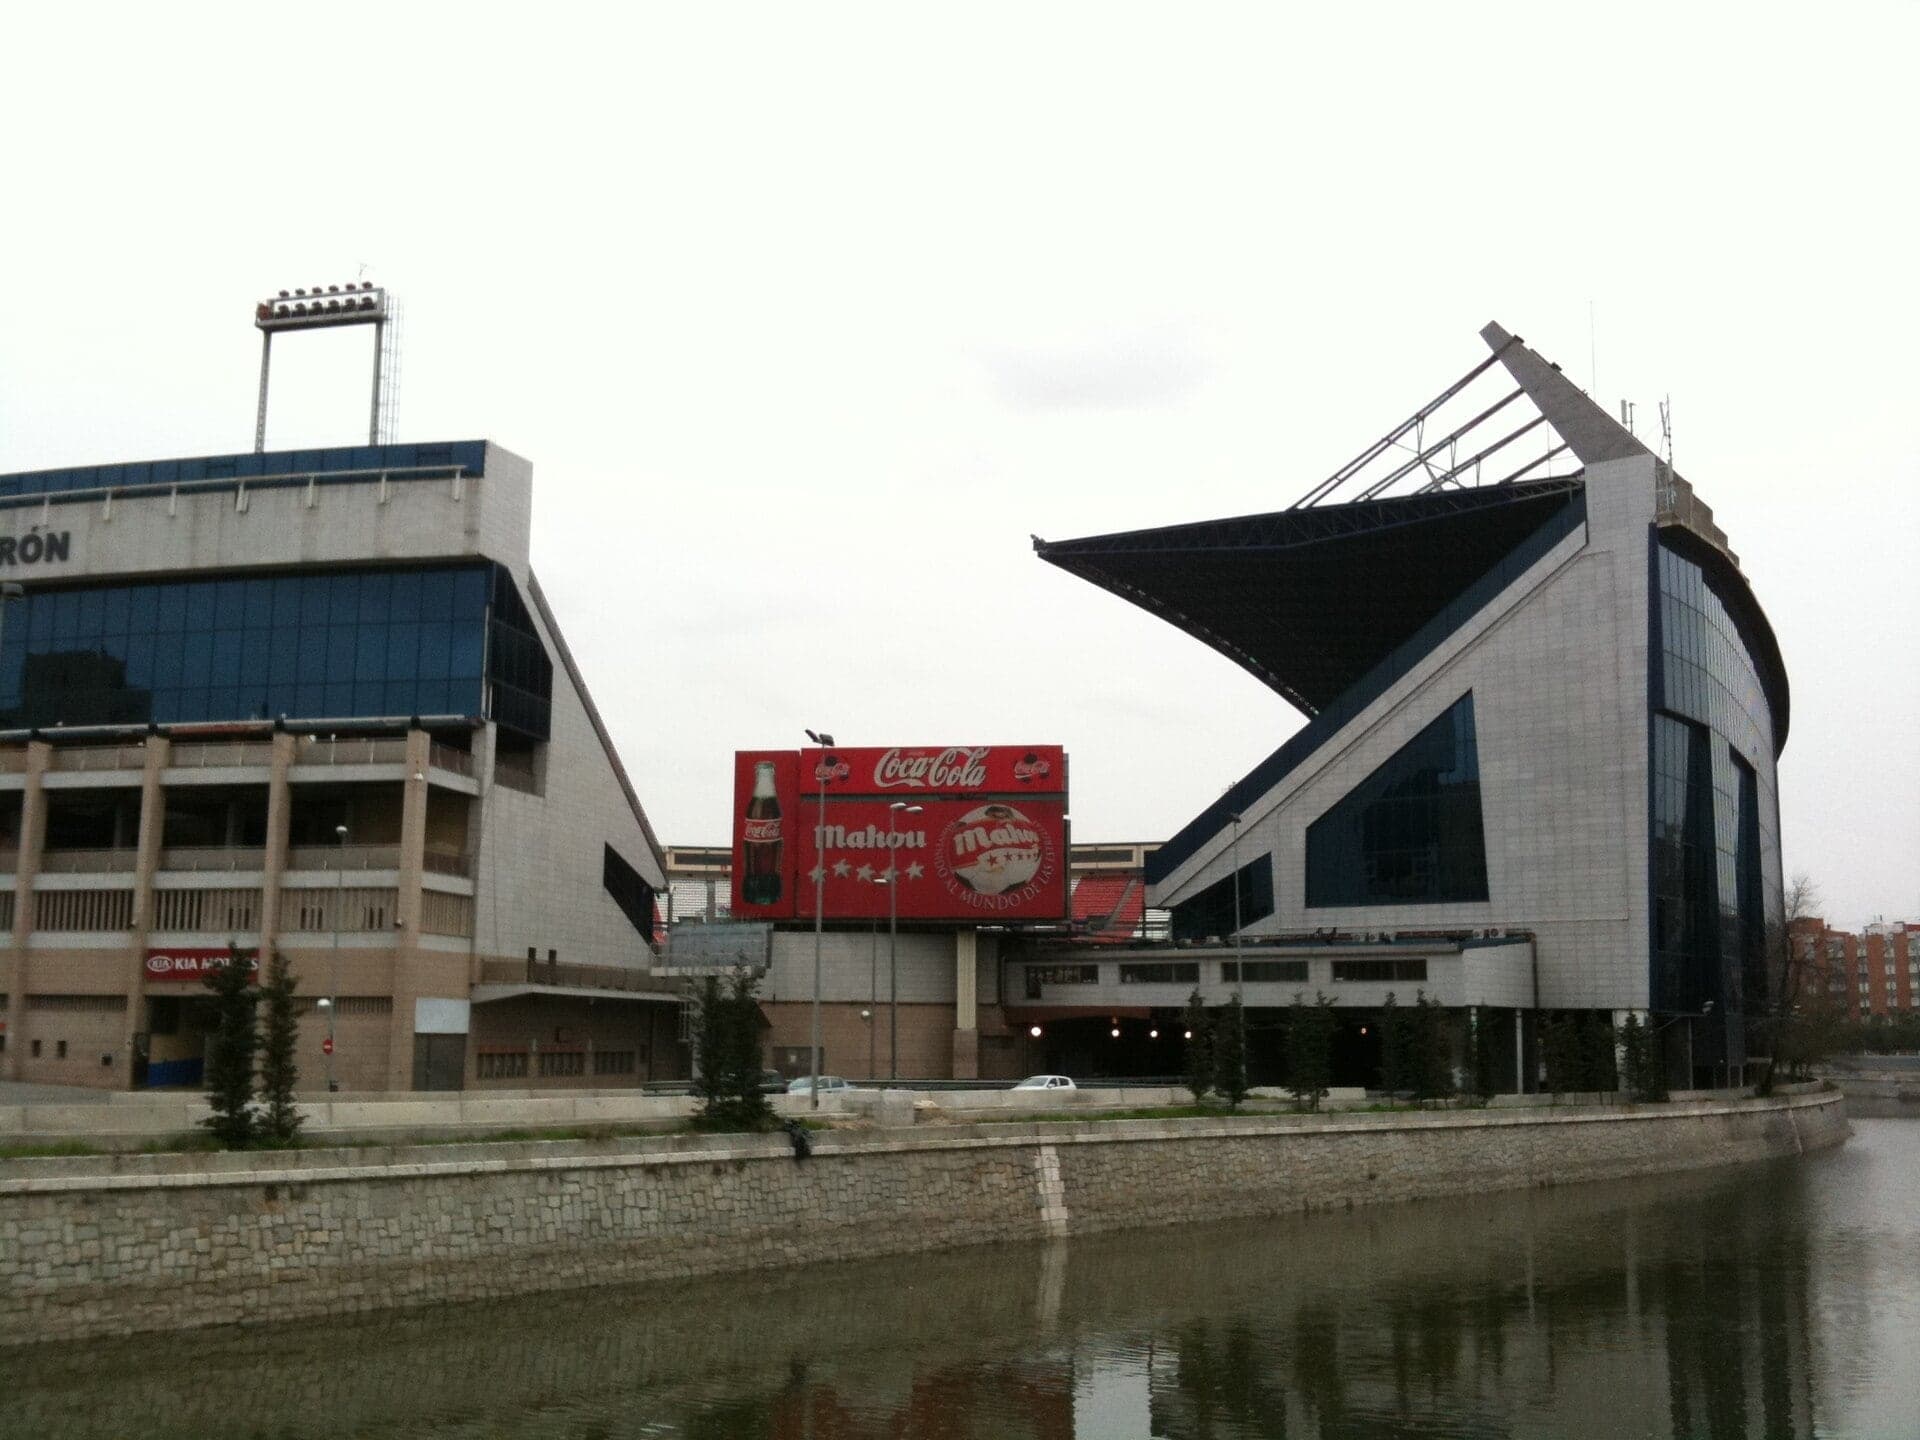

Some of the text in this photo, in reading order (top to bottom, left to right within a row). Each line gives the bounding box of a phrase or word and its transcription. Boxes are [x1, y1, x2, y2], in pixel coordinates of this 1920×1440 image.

[874, 747, 989, 787] Coca-Cola
[815, 825, 926, 849] Mahou
[960, 891, 1020, 912] MUNDO
[1023, 881, 1041, 900] DE
[175, 958, 198, 970] KIA
